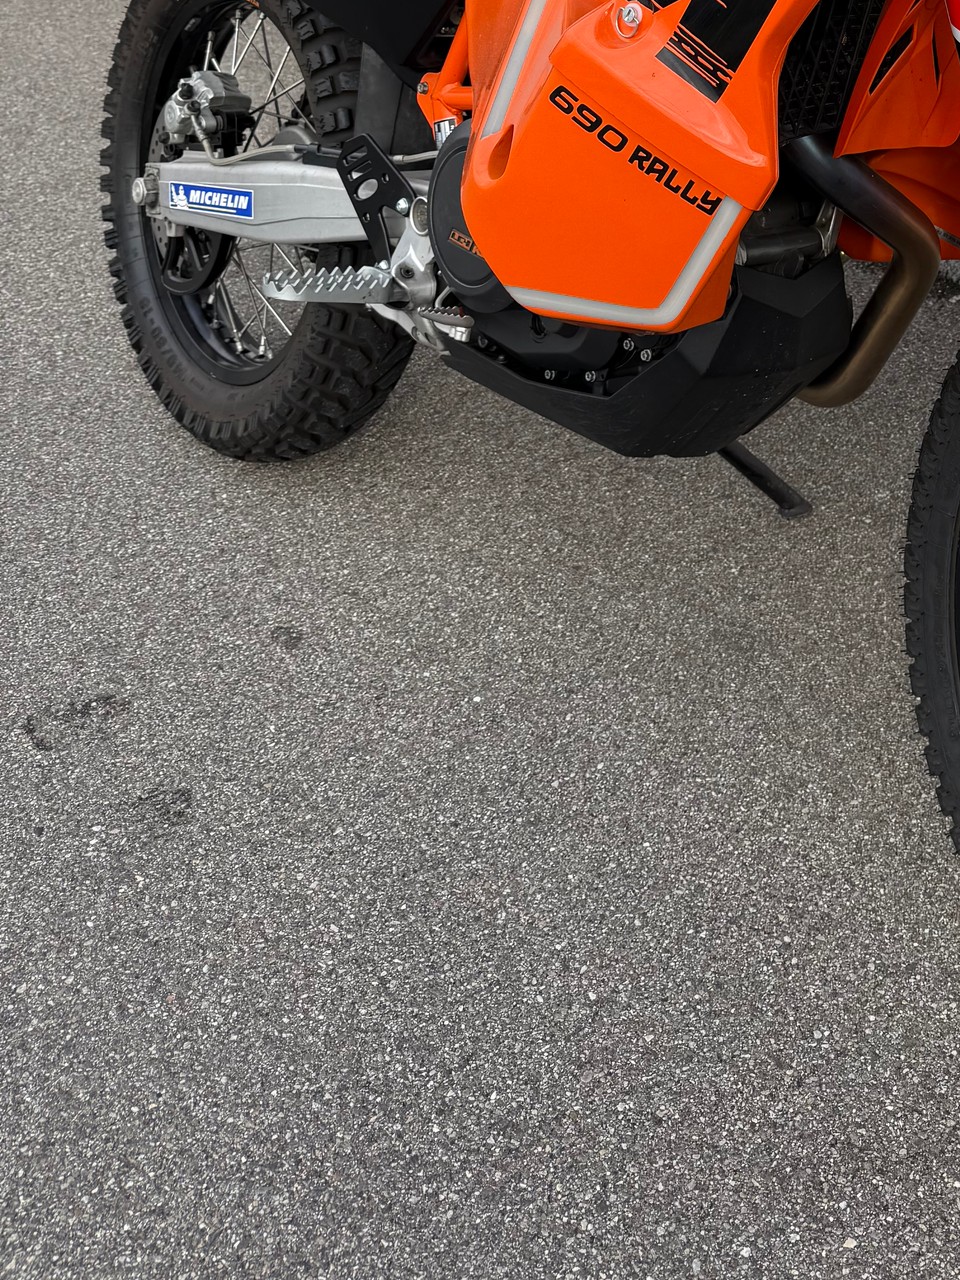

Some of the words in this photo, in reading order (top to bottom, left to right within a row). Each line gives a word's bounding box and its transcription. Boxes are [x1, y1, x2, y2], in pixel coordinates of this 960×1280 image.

[548, 84, 628, 154] 690
[627, 142, 723, 217] RALLY
[189, 189, 249, 210] MICHELIN
